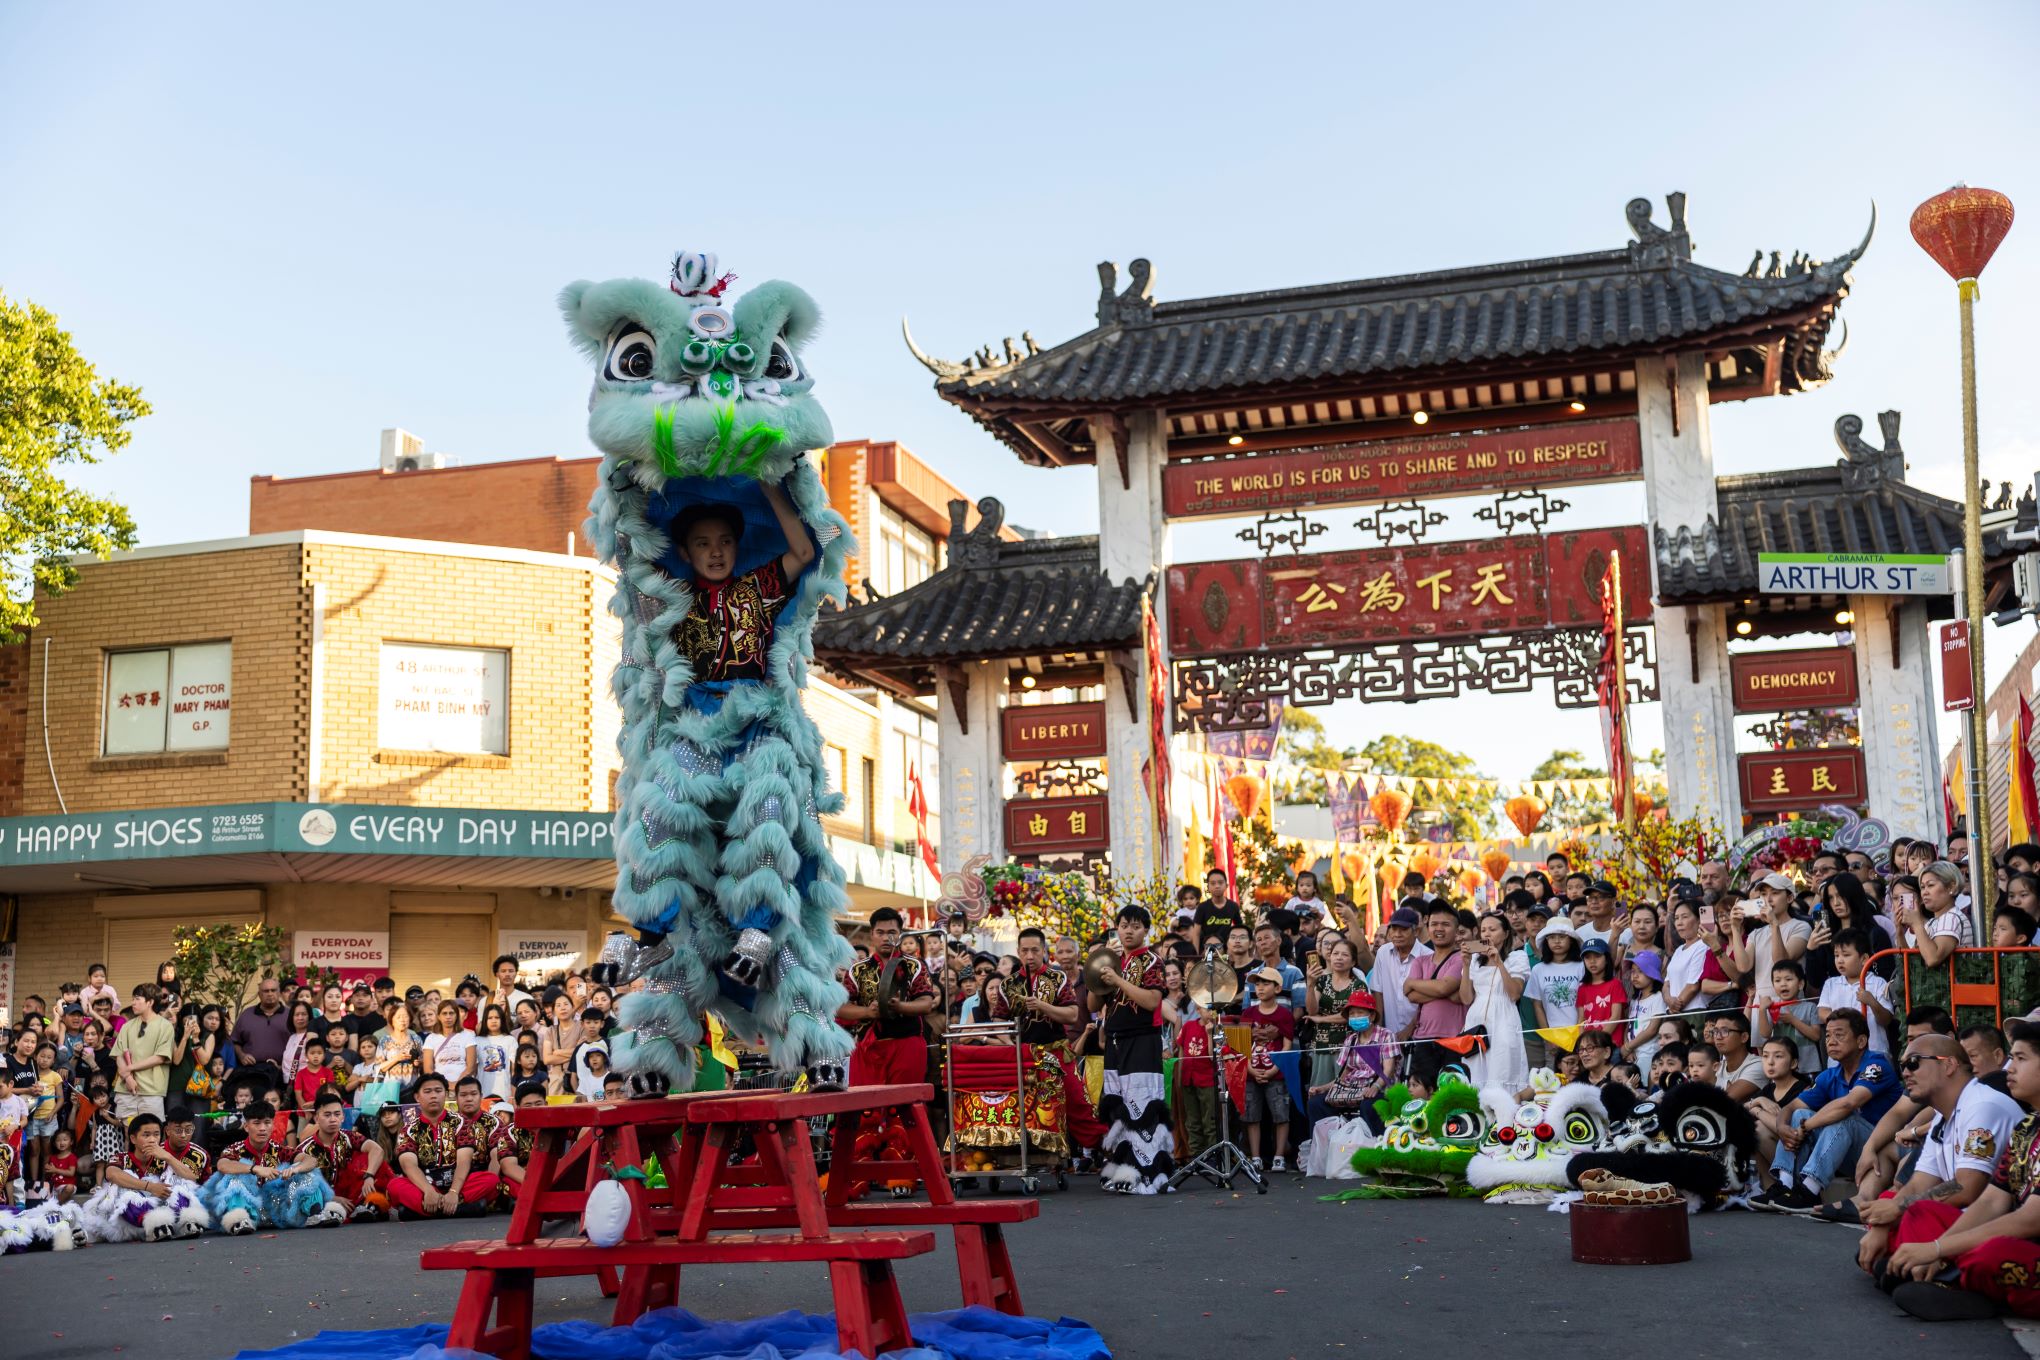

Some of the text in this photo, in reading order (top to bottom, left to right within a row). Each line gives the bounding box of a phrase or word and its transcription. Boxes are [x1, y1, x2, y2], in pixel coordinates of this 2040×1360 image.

[1195, 440, 1608, 495] THE WORLD IS FOR US TO SHARE AND TO RESPECT
[1827, 554, 1885, 563] CABRAMATTA
[1768, 566, 1917, 590] ARTHUR ST
[1950, 627, 1959, 638] NO
[1944, 641, 1967, 652] STOPPING
[396, 660, 417, 673] 48
[1750, 670, 1836, 690] DEMOCRACY
[181, 684, 225, 696] DOCTOR
[173, 699, 230, 714] MARY PHAM
[192, 720, 212, 731] G.P.
[1021, 723, 1089, 740] LIBERTY
[212, 813, 264, 826] 9723 6525
[16, 823, 102, 853] HAPPY
[114, 817, 203, 848] SHOES
[350, 815, 444, 843] EVERY
[459, 818, 517, 845] DAY
[248, 832, 264, 841] 2166
[311, 938, 373, 948] EVERYDAY
[519, 941, 568, 950] EVERYDAY
[301, 951, 382, 960] HAPPY SHOES
[511, 952, 543, 960] HAPPY
